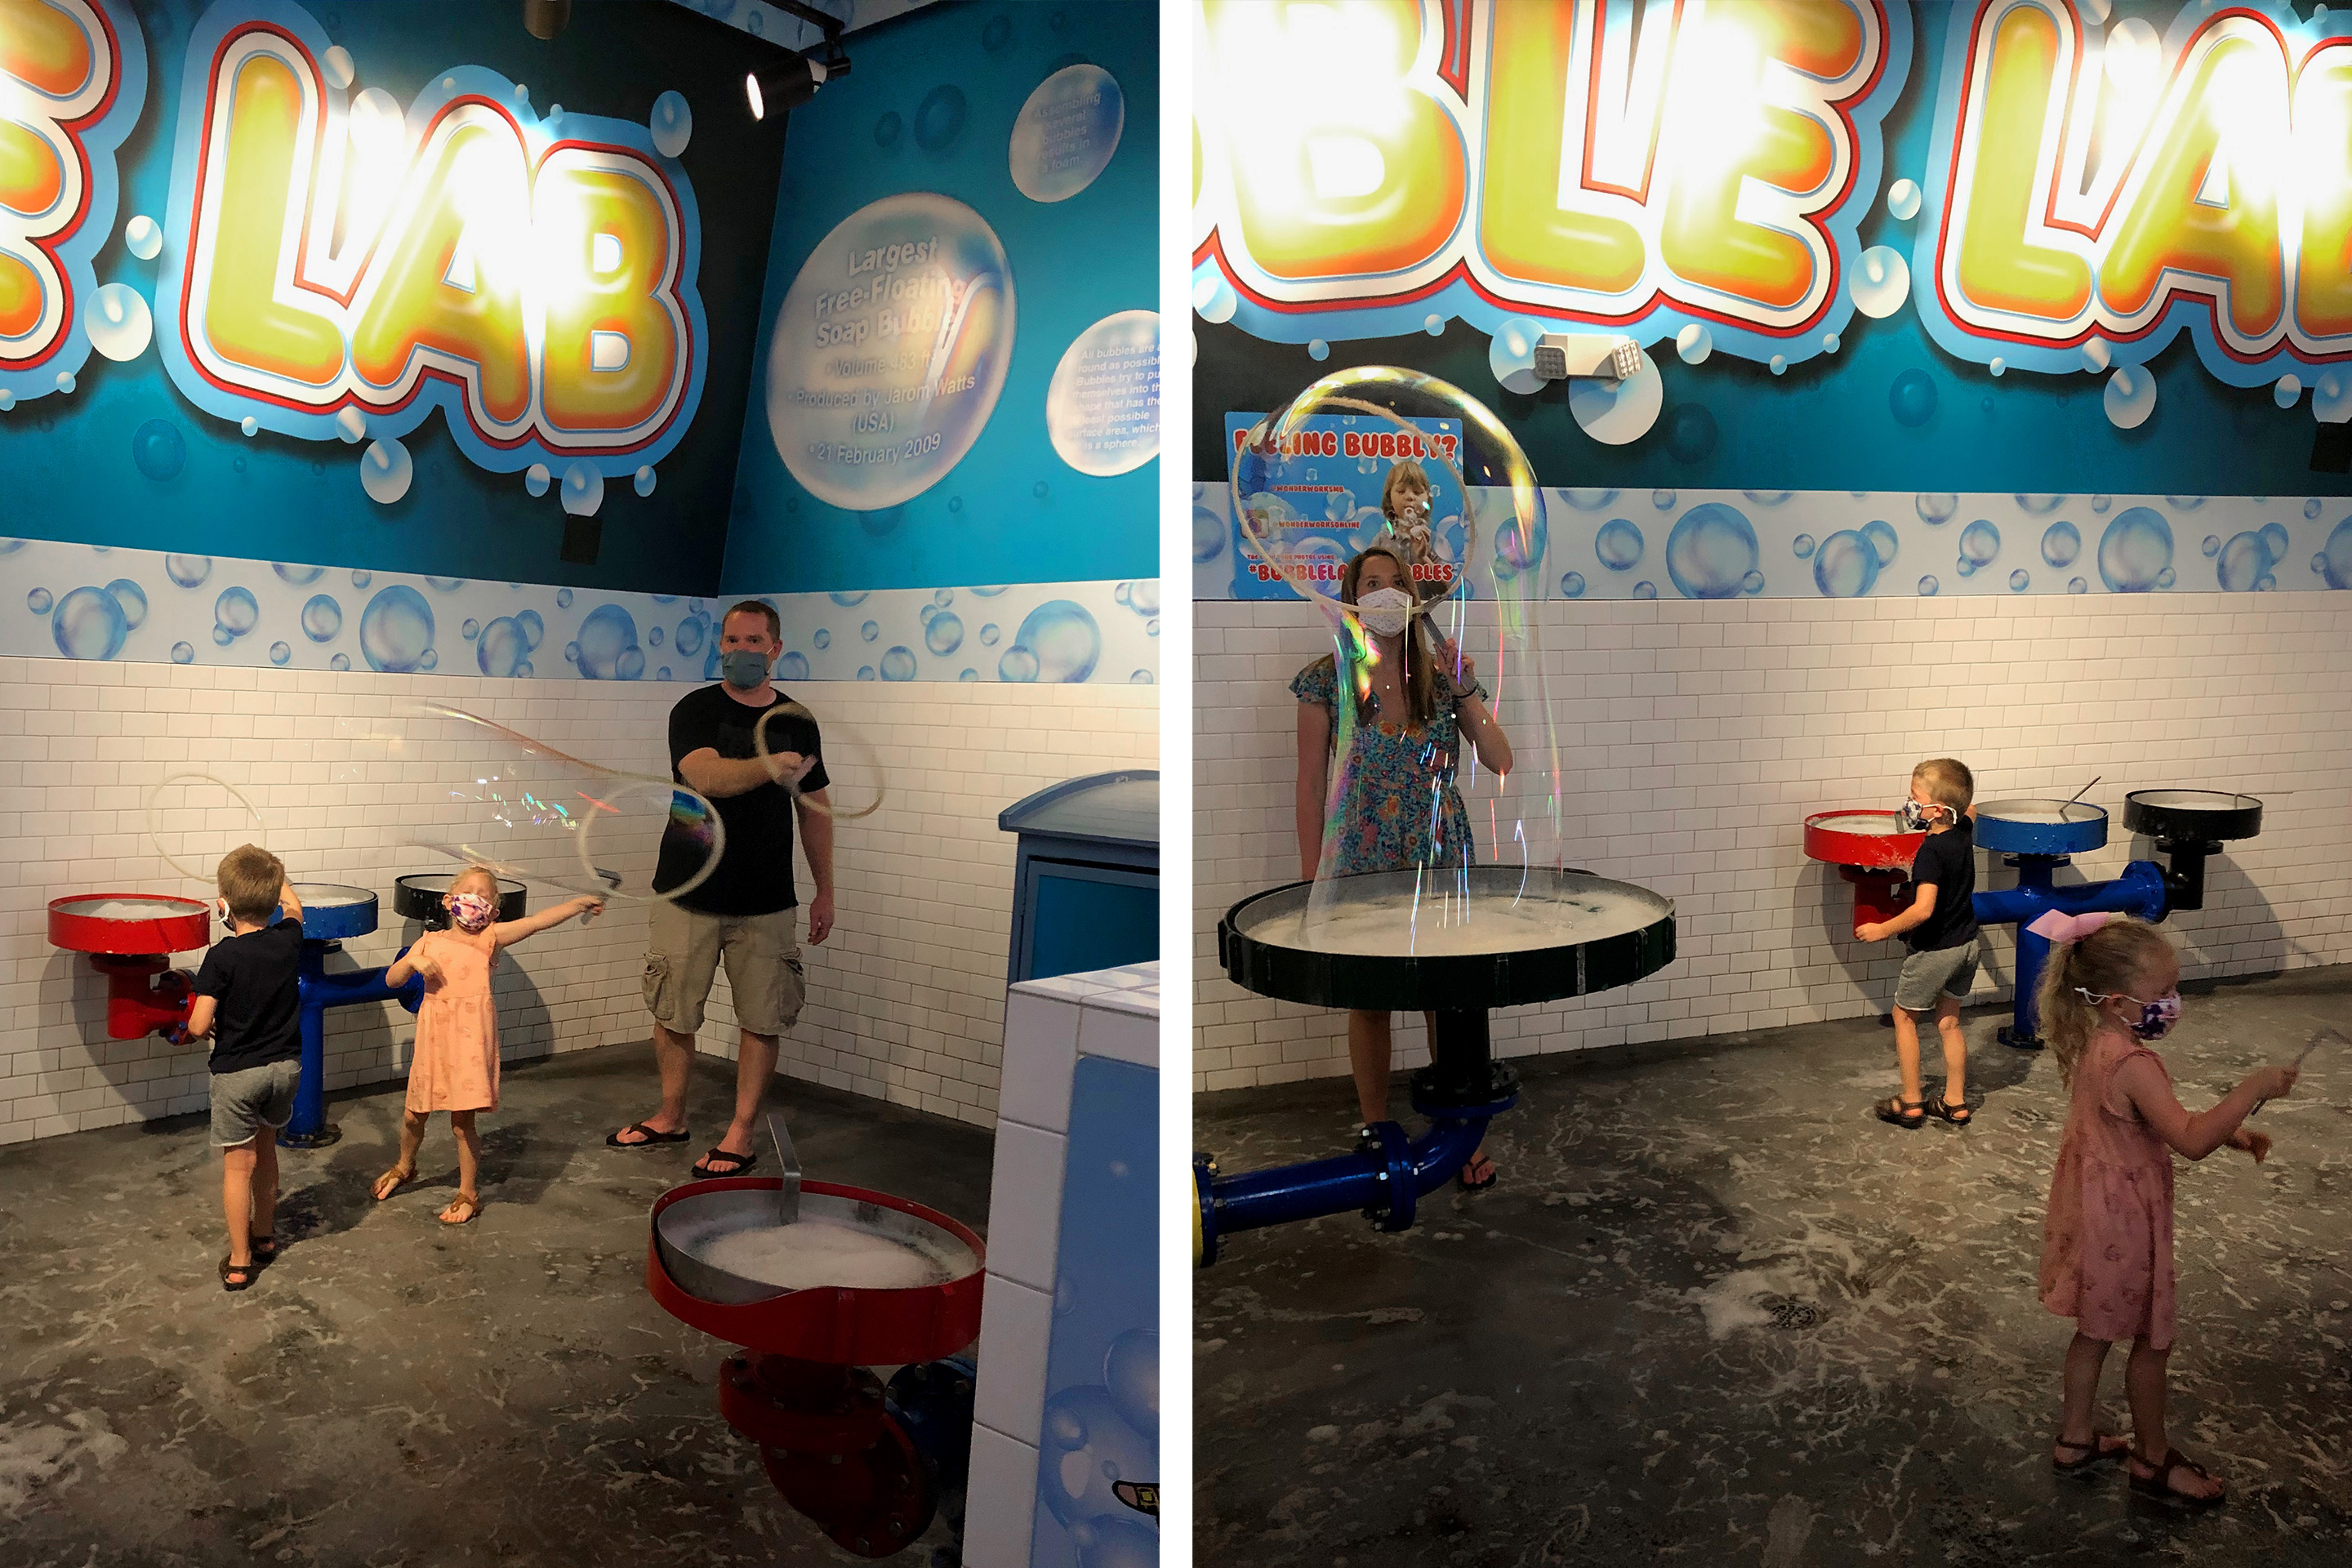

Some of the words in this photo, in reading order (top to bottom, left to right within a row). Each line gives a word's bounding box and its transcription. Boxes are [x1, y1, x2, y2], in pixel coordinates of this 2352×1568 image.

[1034, 91, 1102, 118] Assembling
[1045, 109, 1087, 129] several
[1043, 124, 1087, 145] bubbles
[1037, 142, 1076, 161] results
[1079, 138, 1090, 149] in
[1042, 165, 1049, 173] a
[1193, 0, 1878, 333] BLE
[180, 20, 694, 459] LAB
[848, 235, 938, 277] Largest
[815, 273, 968, 319] Free-Floating
[817, 318, 870, 348] Soap
[1080, 350, 1094, 359] All
[1097, 345, 1136, 359] bubbles
[1138, 344, 1154, 354] are
[837, 356, 885, 377] Volume
[889, 353, 915, 372] 483
[1078, 362, 1107, 373] round
[1108, 363, 1120, 371] as
[1123, 356, 1160, 370] possibl
[1076, 375, 1116, 386] Bubbles
[1119, 372, 1132, 384] try
[1135, 372, 1145, 381] to
[1147, 371, 1160, 381] pu
[796, 389, 858, 408] Produced
[863, 390, 880, 410] by
[884, 383, 930, 405] Jarom
[933, 375, 976, 397] Watts
[1072, 387, 1127, 399] themselves
[1129, 385, 1149, 394] into
[1152, 383, 1160, 392] th
[1072, 401, 1102, 412] shape
[1104, 399, 1124, 409] that
[1126, 398, 1144, 408] has
[853, 409, 894, 435] (USA)
[1082, 414, 1105, 425] least
[1107, 411, 1150, 424] possible
[1132, 422, 1160, 434] which
[817, 443, 831, 461] 21
[837, 444, 899, 466] February
[904, 432, 941, 460] 2009
[1085, 442, 1093, 450] is
[1095, 441, 1101, 449] a
[1343, 431, 1458, 460] BUBBLY?
[1271, 484, 1344, 493] @WONDERWORKSMB
[1274, 520, 1361, 529] @WONDERWORKSONLINE
